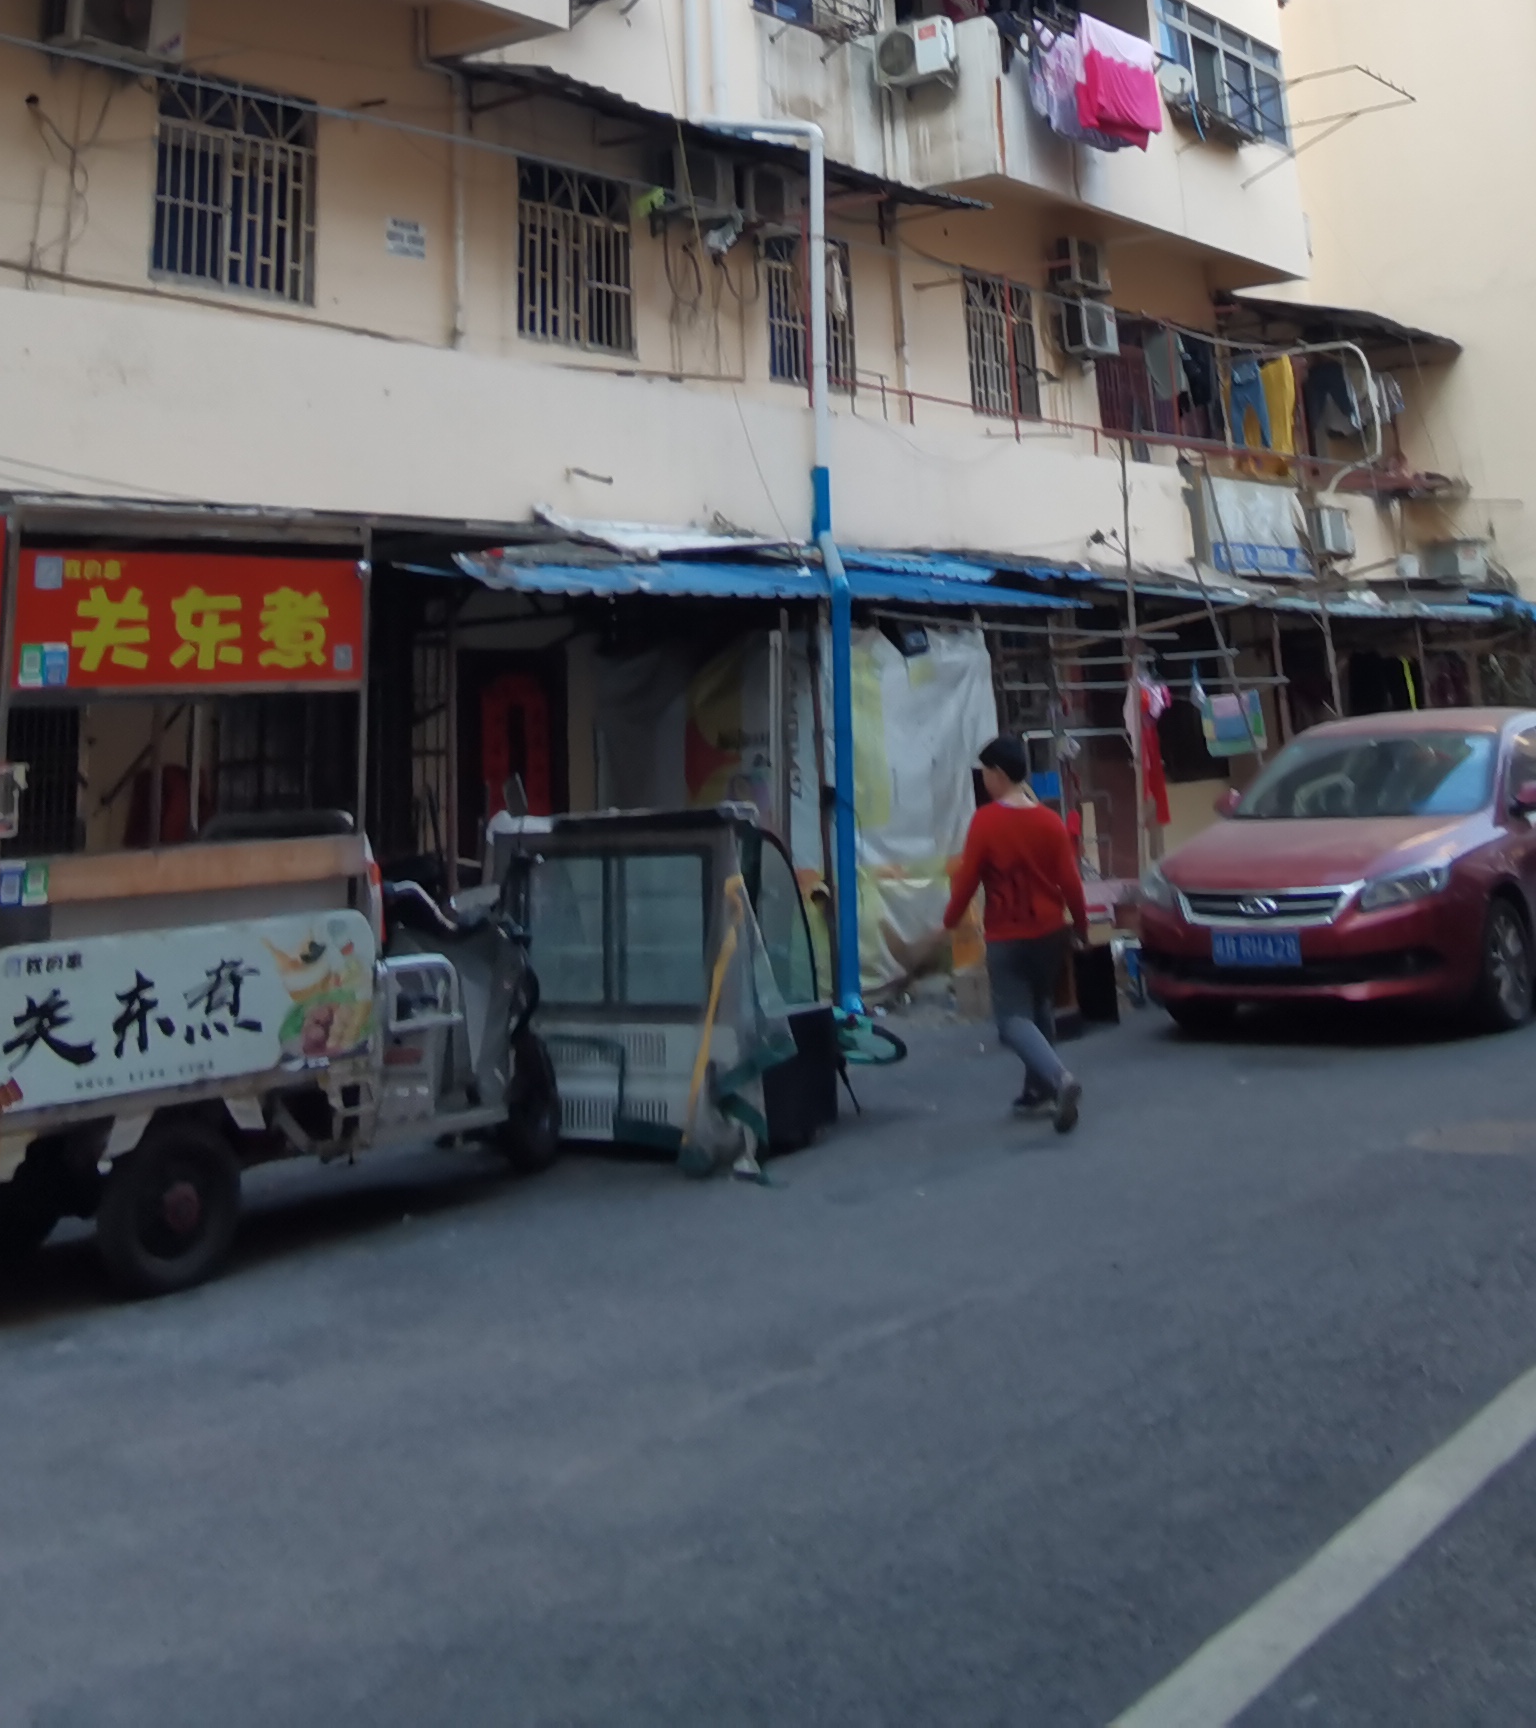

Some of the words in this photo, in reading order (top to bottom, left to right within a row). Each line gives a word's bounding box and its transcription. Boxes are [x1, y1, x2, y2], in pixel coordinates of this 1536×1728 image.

[71, 586, 331, 673] 关东煮
[1, 958, 264, 1070] 关东煮
